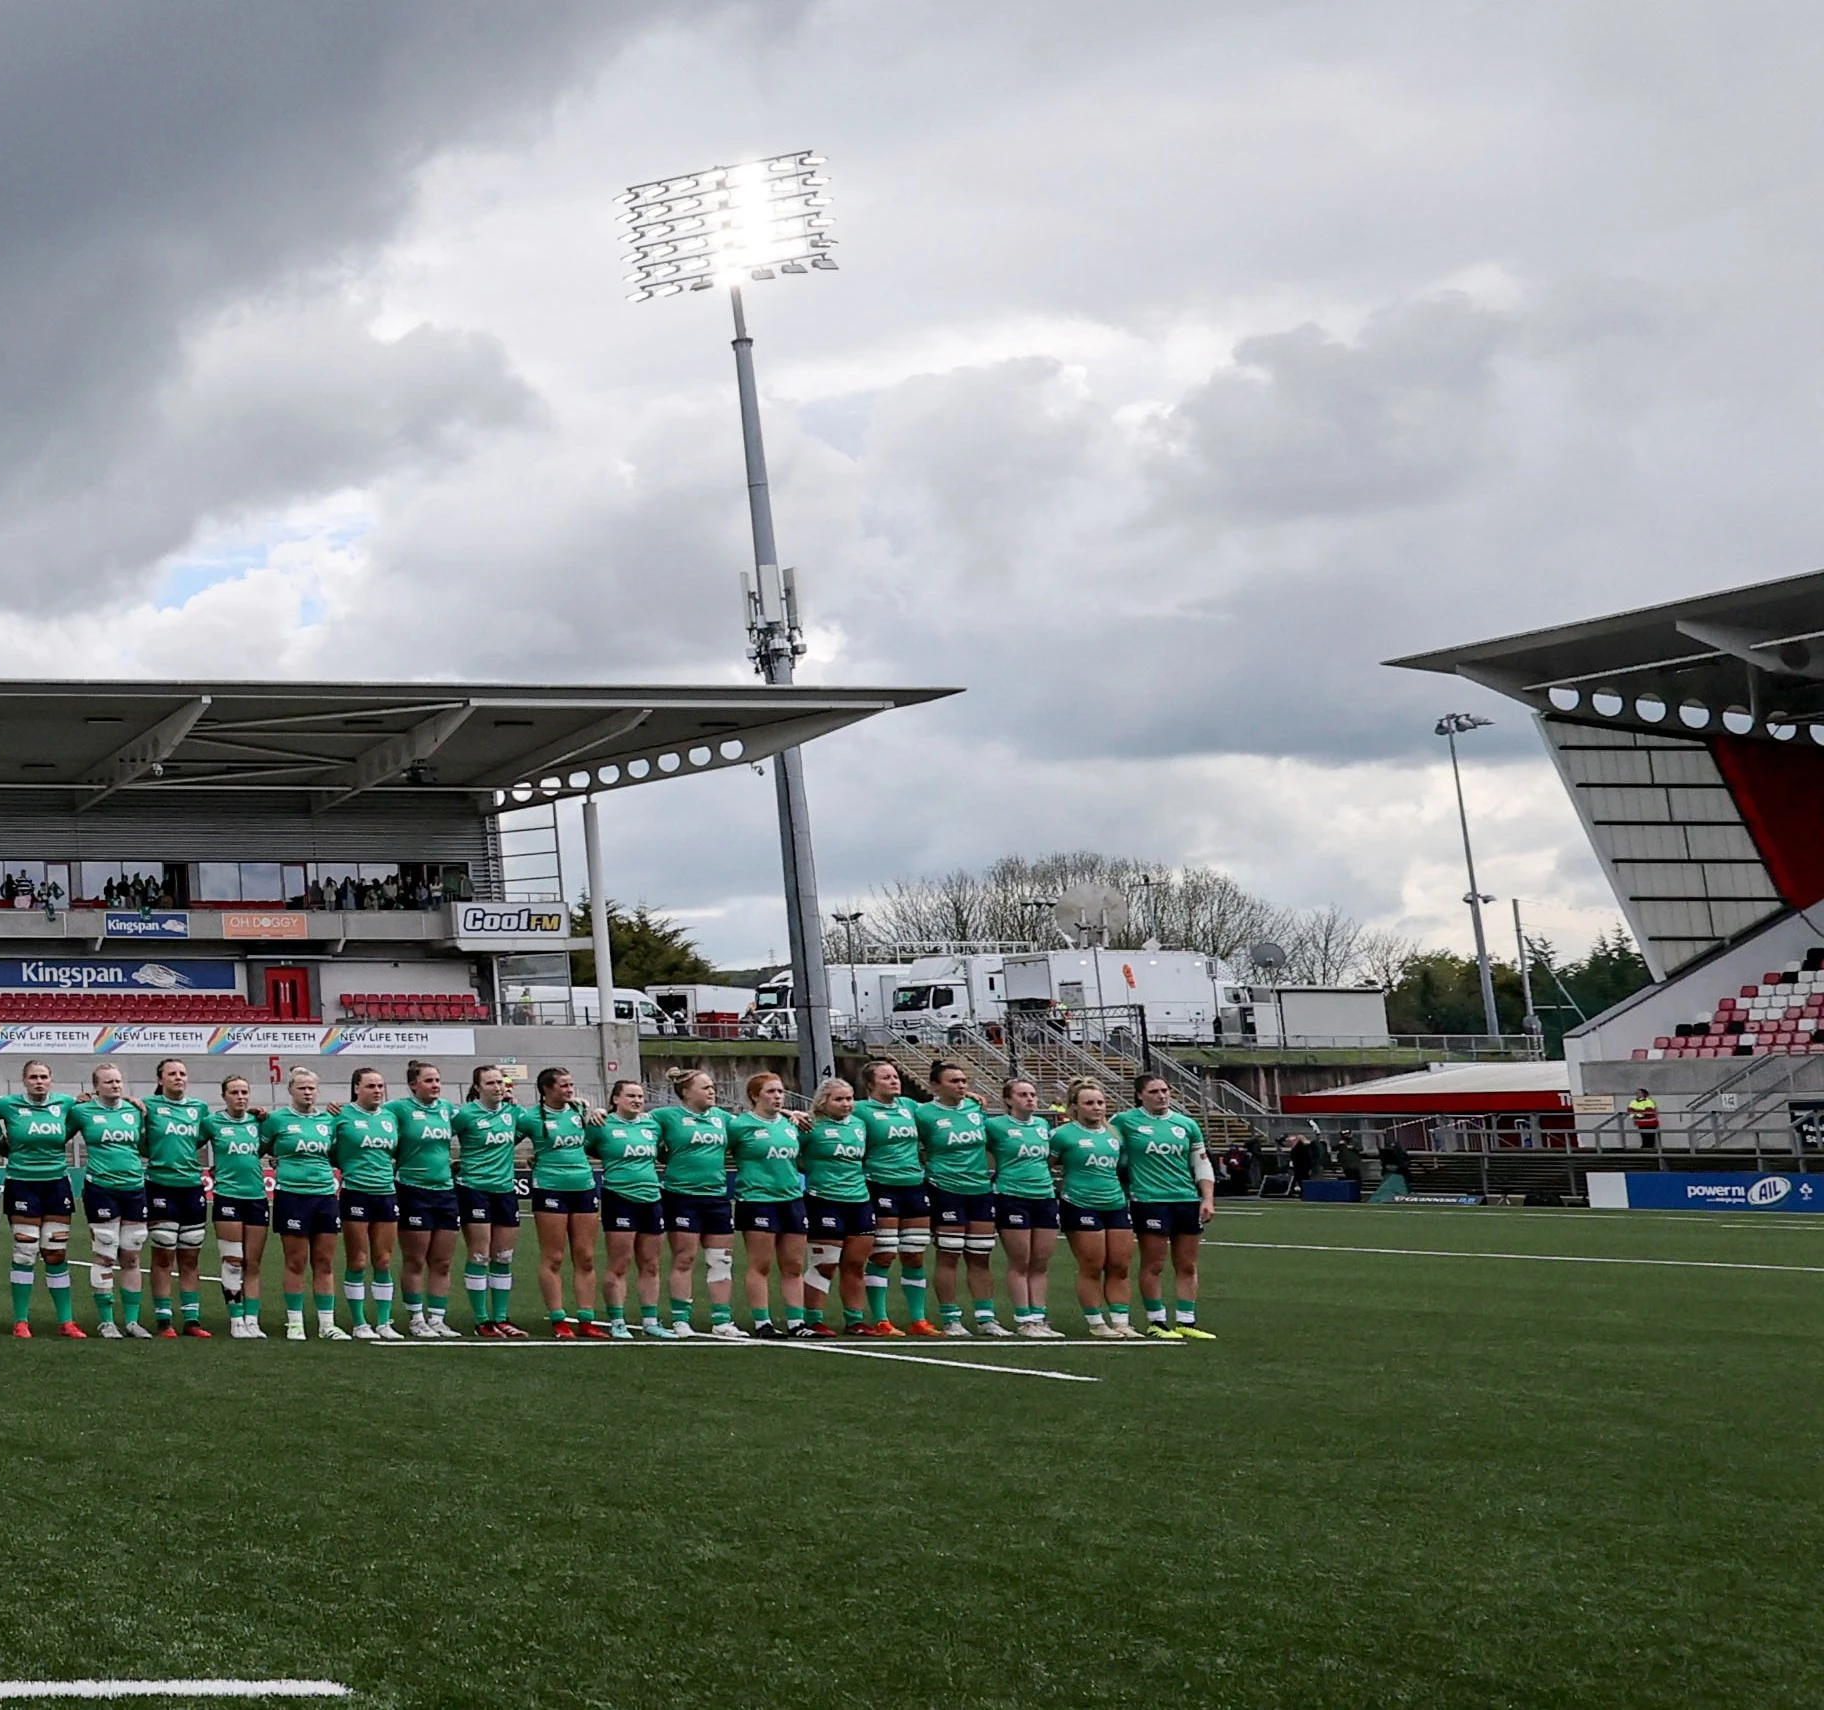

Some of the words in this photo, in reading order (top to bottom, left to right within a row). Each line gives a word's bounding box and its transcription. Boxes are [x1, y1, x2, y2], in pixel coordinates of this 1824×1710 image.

[107, 919, 159, 933] Kingspan
[230, 916, 249, 928] OH
[21, 962, 123, 986] Kingspan
[0, 1031, 27, 1039] NEW
[29, 1031, 52, 1040] LIFE
[56, 1031, 89, 1040] TEETH
[113, 1032, 140, 1040] NEW
[143, 1032, 166, 1041] LIFE
[169, 1032, 203, 1041] TEETH
[227, 1032, 254, 1040] NEW
[256, 1032, 279, 1041] LIFE
[283, 1032, 316, 1041] TEETH
[340, 1033, 367, 1041] NEW
[369, 1033, 392, 1042] LIFE
[395, 1033, 428, 1042] TEETH
[269, 1056, 282, 1084] 5
[822, 1065, 832, 1076] 4
[28, 1122, 62, 1134] AON
[165, 1122, 197, 1136] AON
[422, 1126, 451, 1140] AON
[888, 1125, 918, 1139] AON
[102, 1129, 135, 1143] AON
[360, 1135, 394, 1149] AON
[486, 1132, 514, 1145] AON
[553, 1134, 584, 1148] AON
[691, 1130, 724, 1144] AON
[948, 1130, 983, 1145] AON
[228, 1141, 258, 1154] AON
[295, 1139, 328, 1153] AON
[624, 1144, 654, 1158] AON
[767, 1146, 798, 1160] AON
[834, 1144, 864, 1157] AON
[1018, 1144, 1050, 1158] AON
[1146, 1140, 1183, 1155] AON
[1084, 1154, 1118, 1168] AON
[1759, 1181, 1781, 1200] AIL
